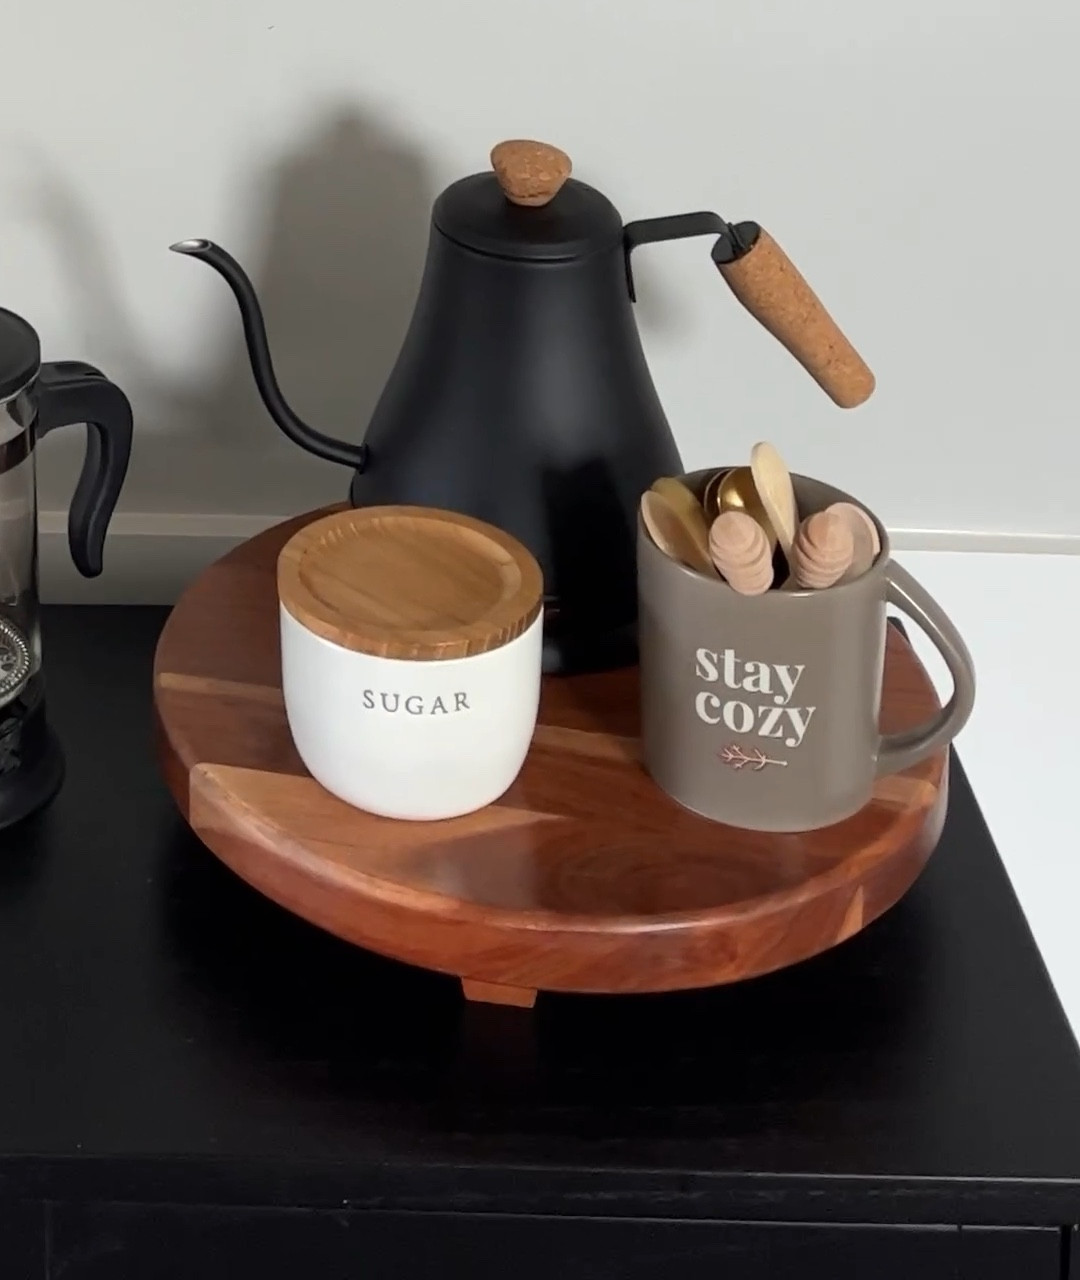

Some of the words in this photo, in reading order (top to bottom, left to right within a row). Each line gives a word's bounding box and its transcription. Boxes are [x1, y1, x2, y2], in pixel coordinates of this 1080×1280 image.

[362, 689, 470, 715] SUGAR
[695, 647, 806, 705] stay
[695, 691, 817, 748] cozy
